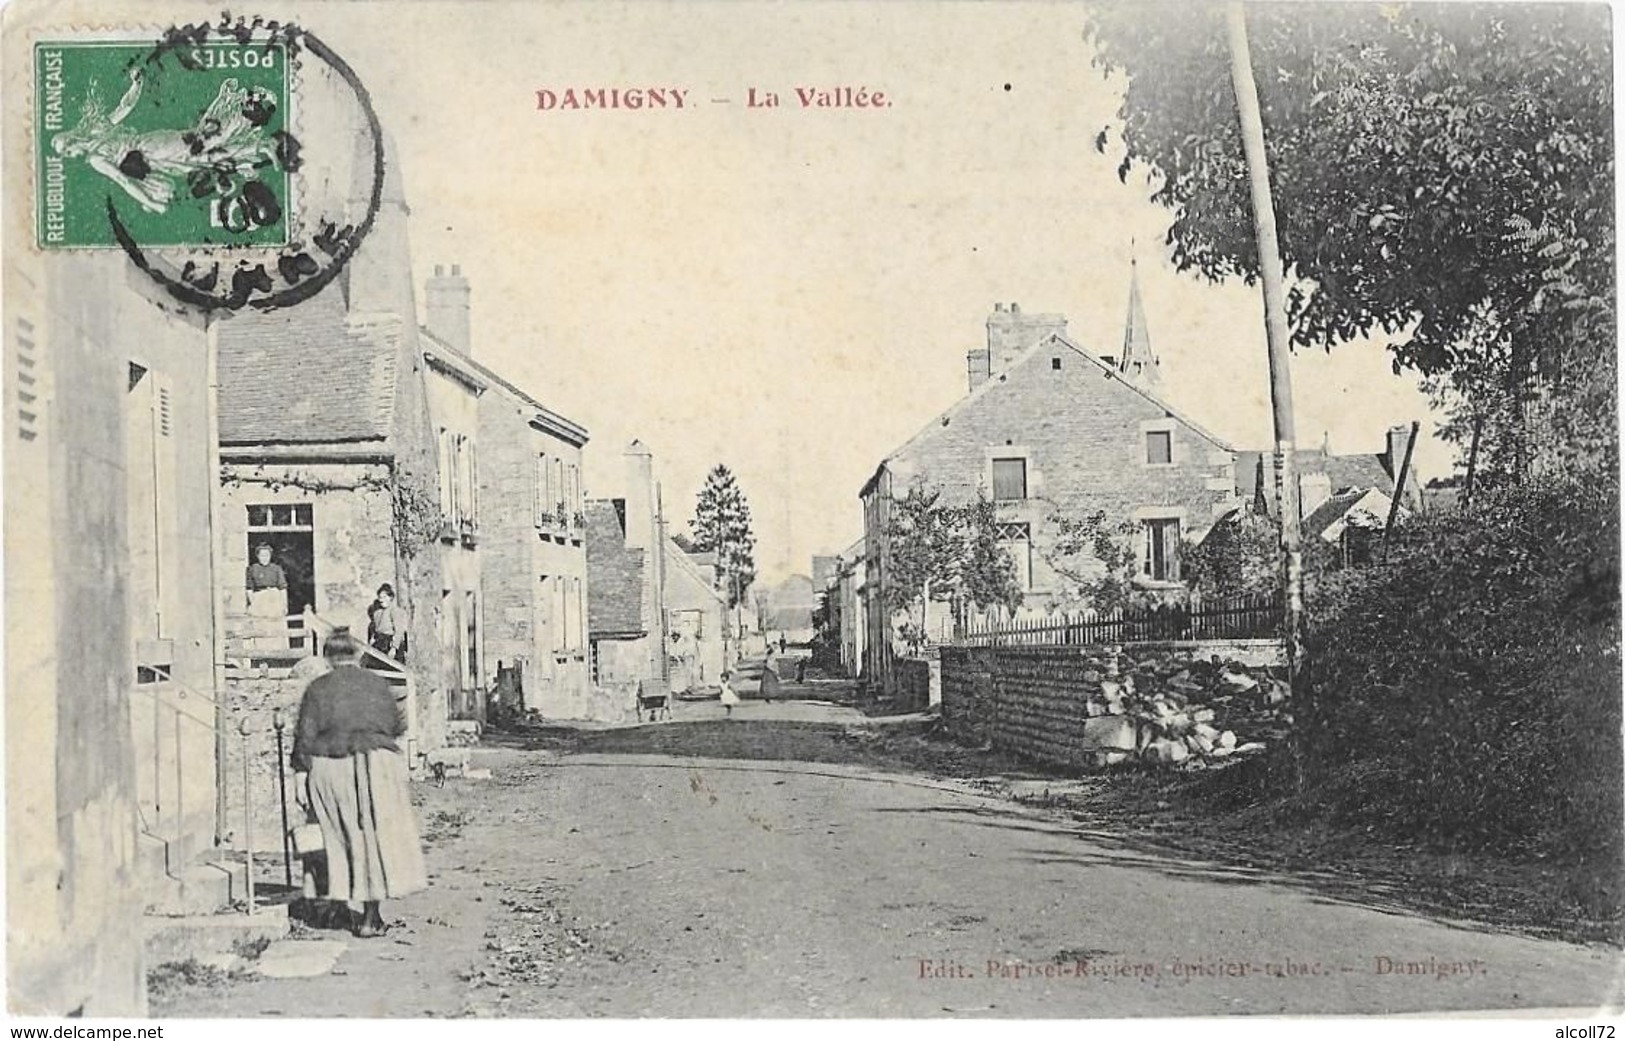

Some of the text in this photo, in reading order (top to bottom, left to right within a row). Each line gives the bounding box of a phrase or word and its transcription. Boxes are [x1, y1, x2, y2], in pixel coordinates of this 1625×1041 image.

[191, 50, 275, 68] POSTES
[45, 50, 65, 242] REPUBLIQUE FRANÇAISE
